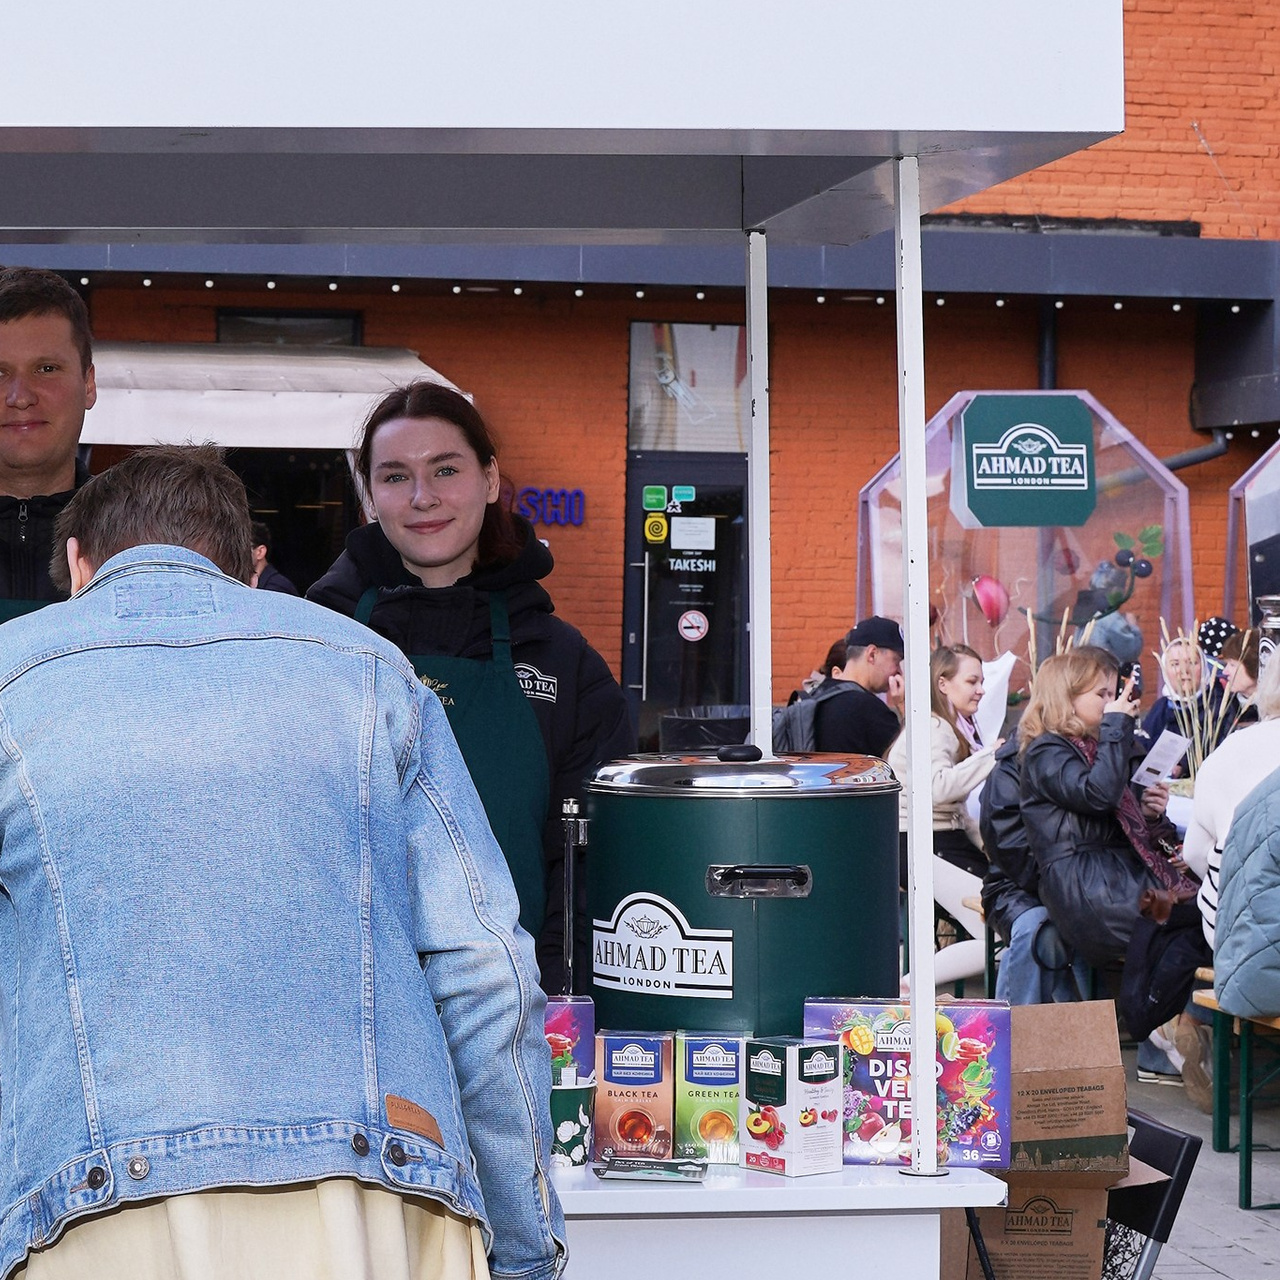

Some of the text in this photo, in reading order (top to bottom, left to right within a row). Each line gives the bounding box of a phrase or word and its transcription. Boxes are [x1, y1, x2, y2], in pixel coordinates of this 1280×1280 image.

[977, 456, 1084, 475] AHMAD TEA
[1012, 477, 1050, 485] LONDON
[668, 557, 716, 572] TAKESHI
[534, 680, 555, 693] TEA
[594, 938, 728, 976] AHMAD TEA
[623, 976, 671, 989] LONDON
[613, 1054, 654, 1063] AHMAD TEA
[694, 1054, 734, 1063] AHMAD TEA
[752, 1060, 781, 1070] AHMAD TEA
[869, 1059, 943, 1079] DIS
[607, 1090, 638, 1098] BLACK
[687, 1090, 720, 1098] GREEN
[1040, 1086, 1075, 1095] ENVELOPED
[1076, 1084, 1105, 1093] TEABAGS
[882, 1100, 912, 1119] TE
[604, 1147, 613, 1155] 20
[685, 1147, 694, 1155] 20
[962, 1149, 979, 1161] 36
[1007, 1215, 1070, 1226] AHMAD TEA
